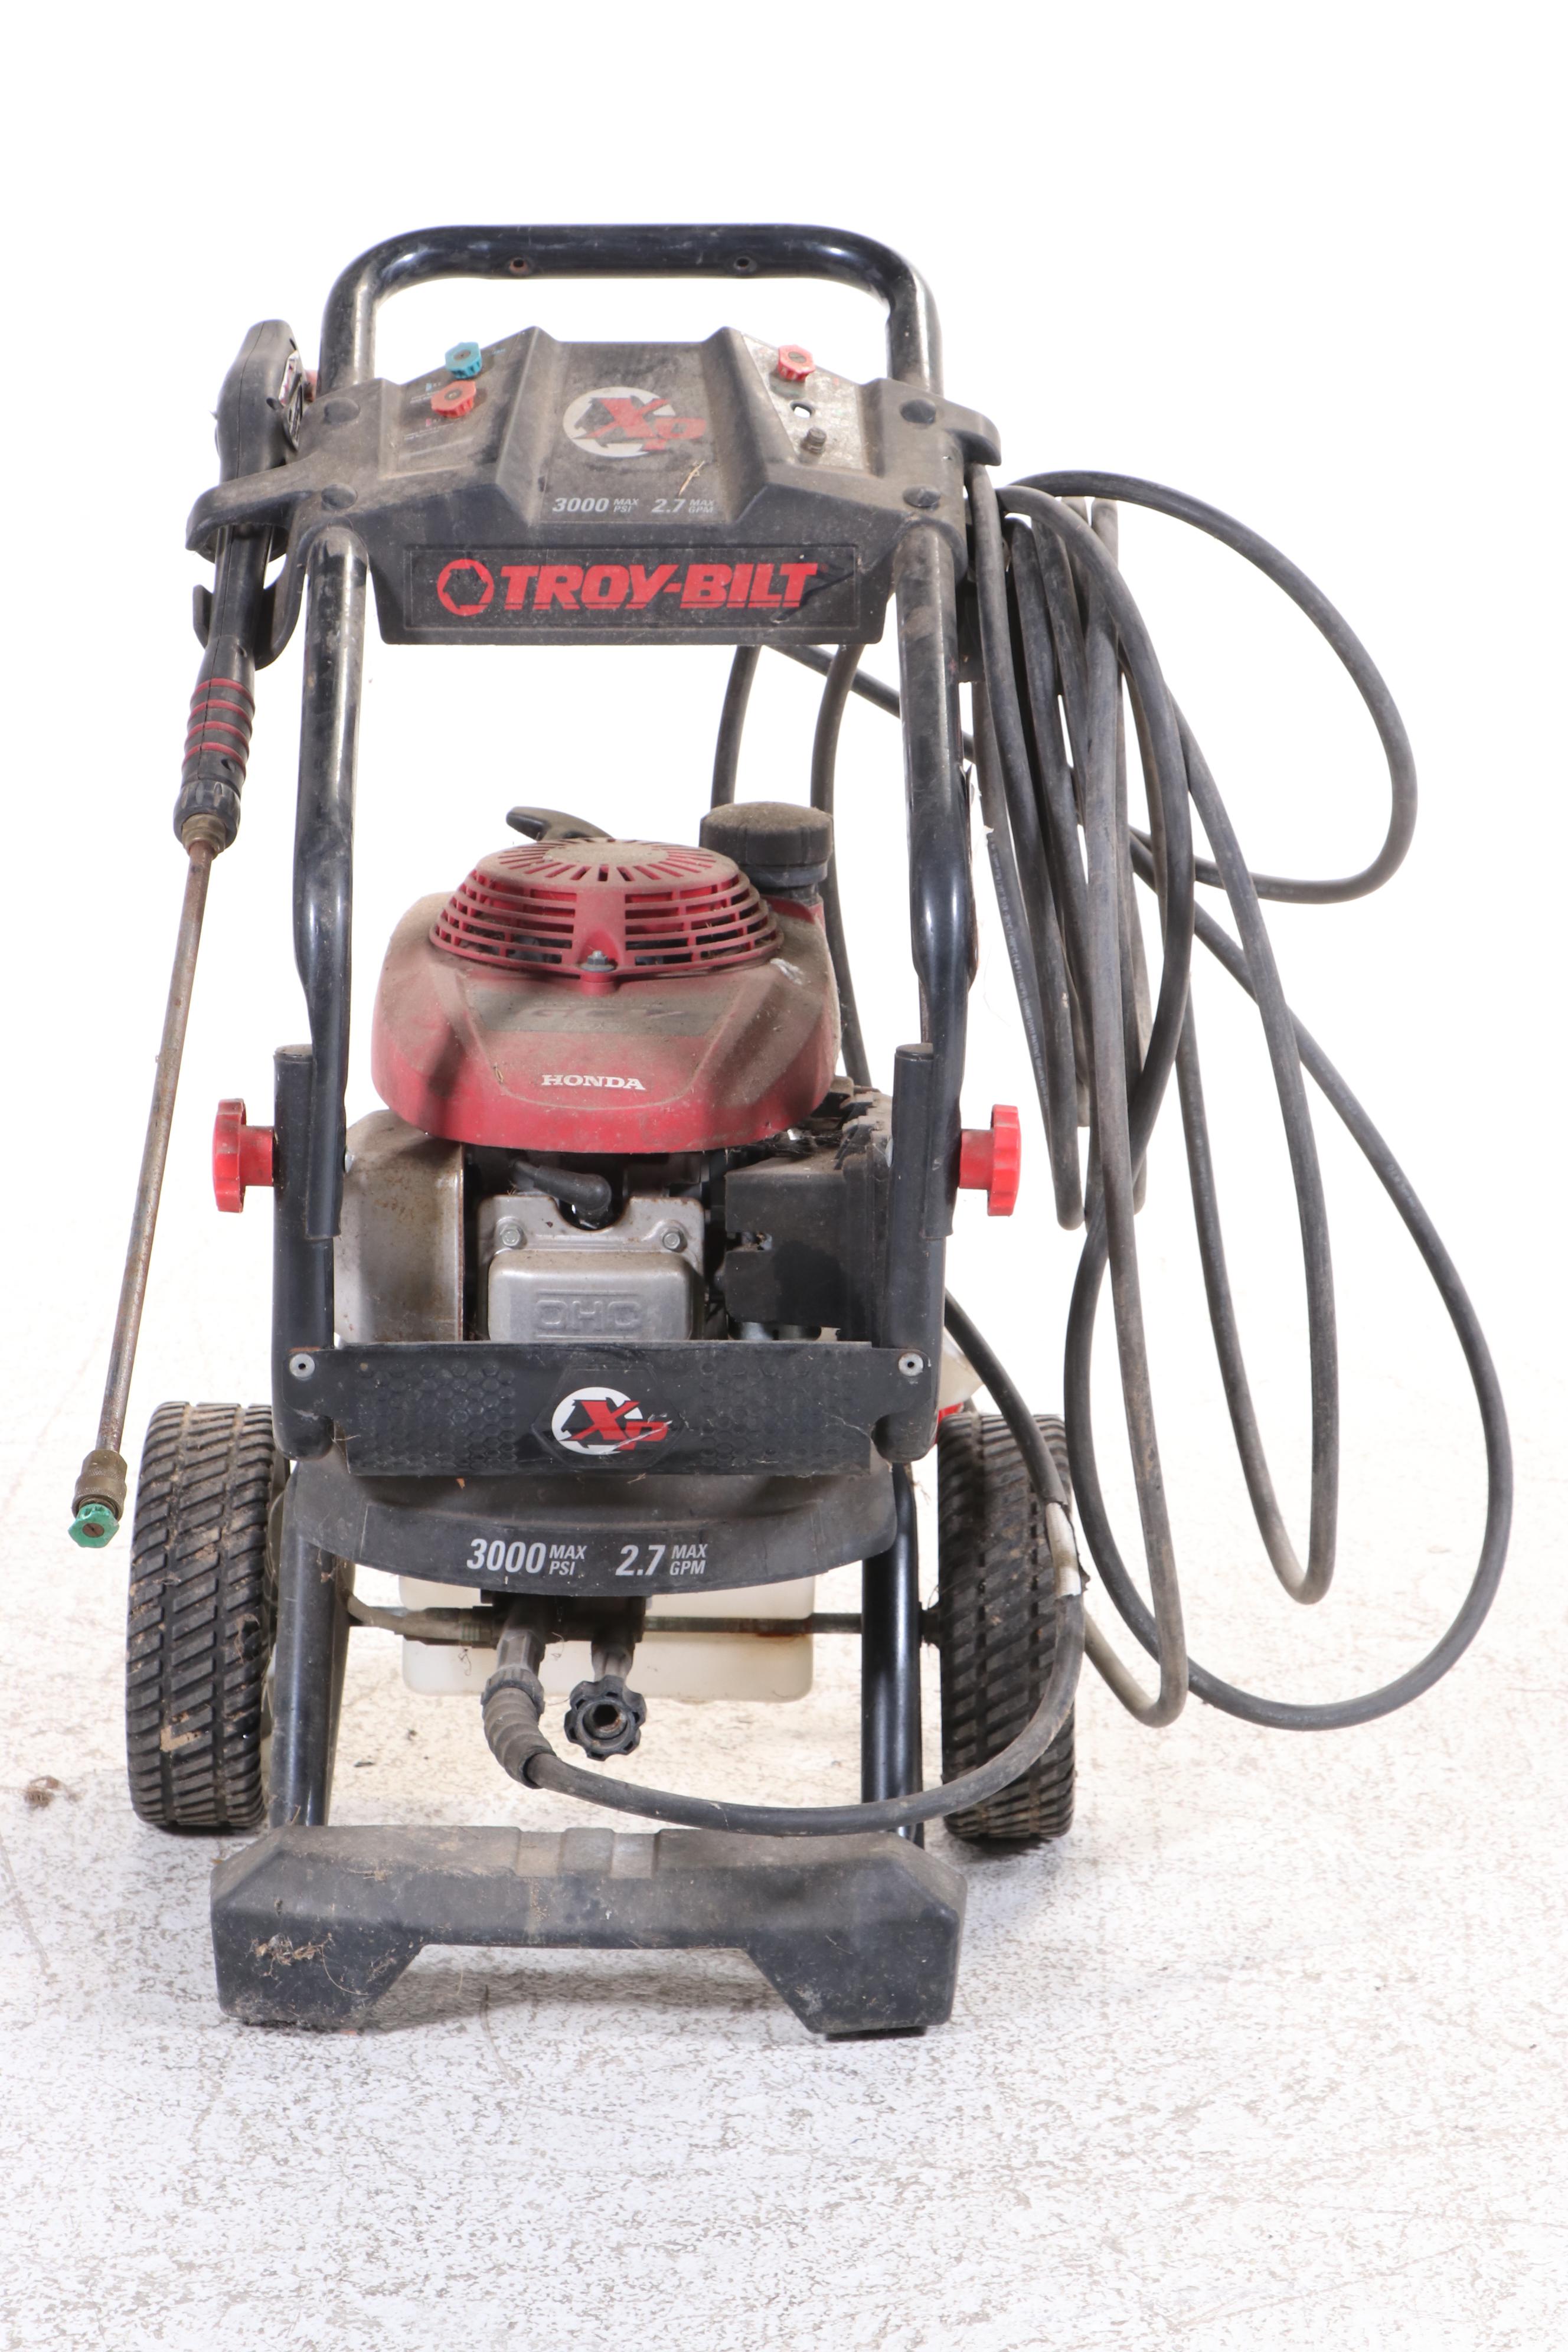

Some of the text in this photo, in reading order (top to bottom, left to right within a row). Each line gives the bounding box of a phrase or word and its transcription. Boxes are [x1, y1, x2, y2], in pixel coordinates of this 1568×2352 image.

[551, 497, 639, 513] 3000 MAX
[651, 498, 687, 513] 2.7
[499, 563, 818, 610] TROY-BILT
[541, 1074, 646, 1090] HONDA
[535, 1300, 641, 1331] OHC
[466, 1538, 588, 1574] 3000 MAX
[615, 1543, 708, 1576] 2.7 MAX
[548, 1561, 576, 1576] PSI
[669, 1560, 707, 1576] GPM
